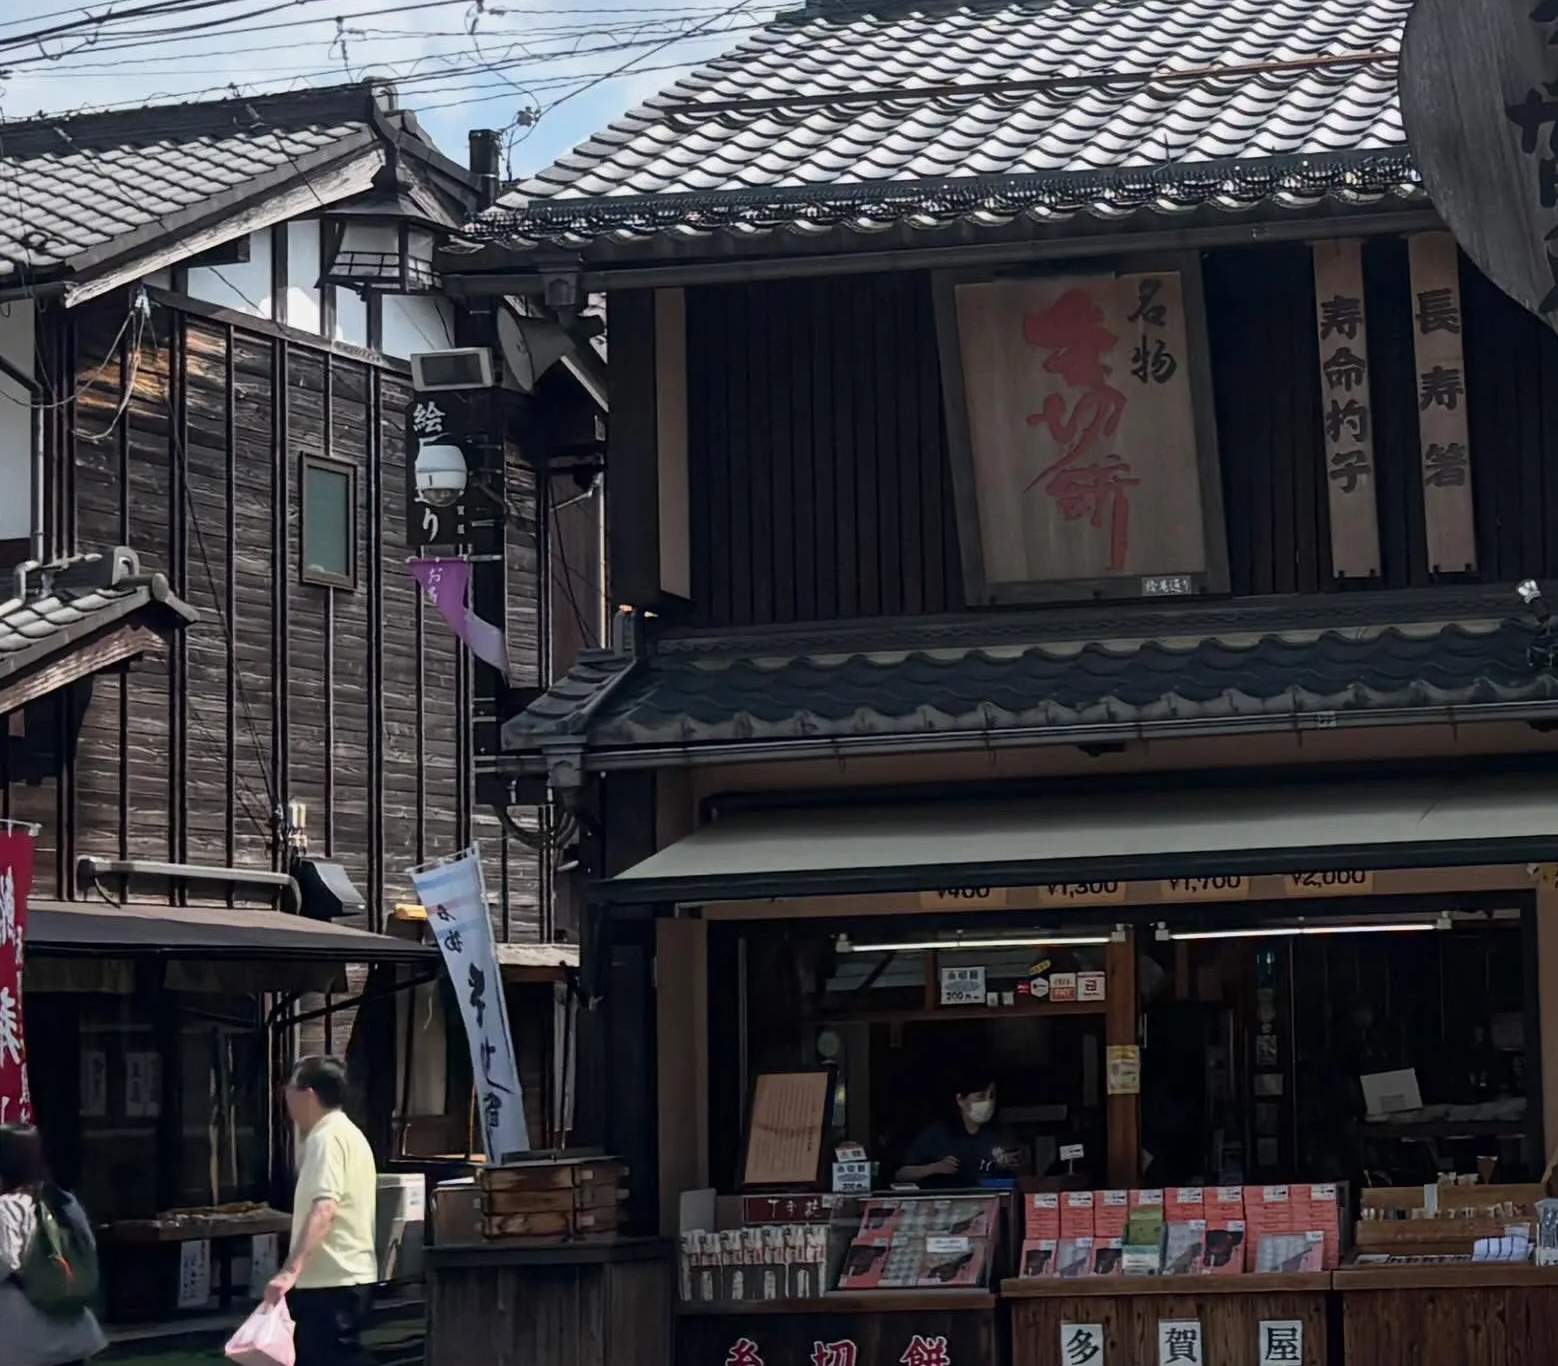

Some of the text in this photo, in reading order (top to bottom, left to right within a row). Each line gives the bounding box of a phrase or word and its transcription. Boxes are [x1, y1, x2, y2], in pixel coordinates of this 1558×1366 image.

[1127, 278, 1177, 384] 名物
[1320, 295, 1373, 495] 寿命杓子
[1415, 289, 1468, 489] 長寿箸
[412, 400, 449, 542] 絵り
[1067, 1326, 1300, 1366] 多賀屋
